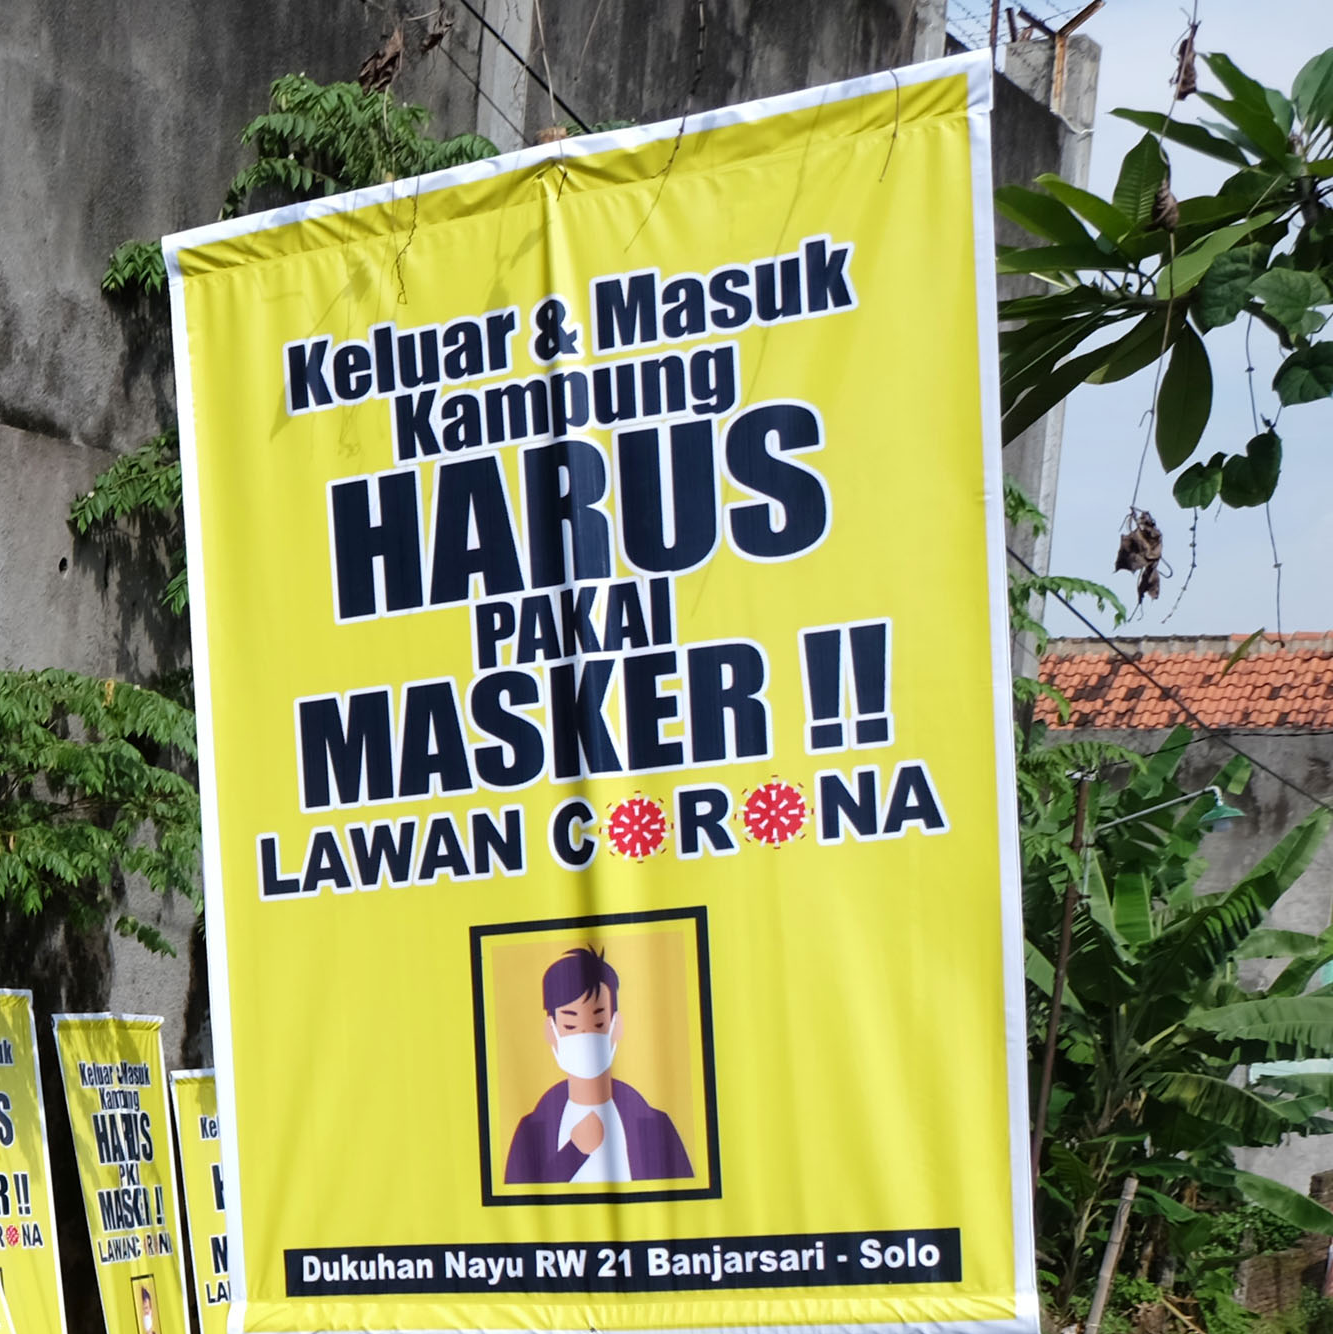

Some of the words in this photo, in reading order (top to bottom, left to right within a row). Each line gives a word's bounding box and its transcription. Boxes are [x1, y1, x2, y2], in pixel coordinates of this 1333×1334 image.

[288, 311, 515, 411] Keluar
[535, 299, 579, 360] &
[594, 239, 853, 350] Masuk
[395, 341, 734, 461] Kampung
[331, 405, 828, 620] HARUS
[475, 578, 672, 669] PAKAI
[298, 643, 771, 809] MASKER
[804, 623, 890, 750] !!
[262, 806, 523, 896] LAWAN
[79, 1062, 113, 1087] Keluar
[302, 1255, 433, 1283] Dukuhan
[445, 1251, 524, 1286] Nayu
[535, 1249, 586, 1278] RW
[597, 1249, 632, 1278] 21
[647, 1241, 824, 1283] Banjarsari
[859, 1238, 940, 1270] Solo
